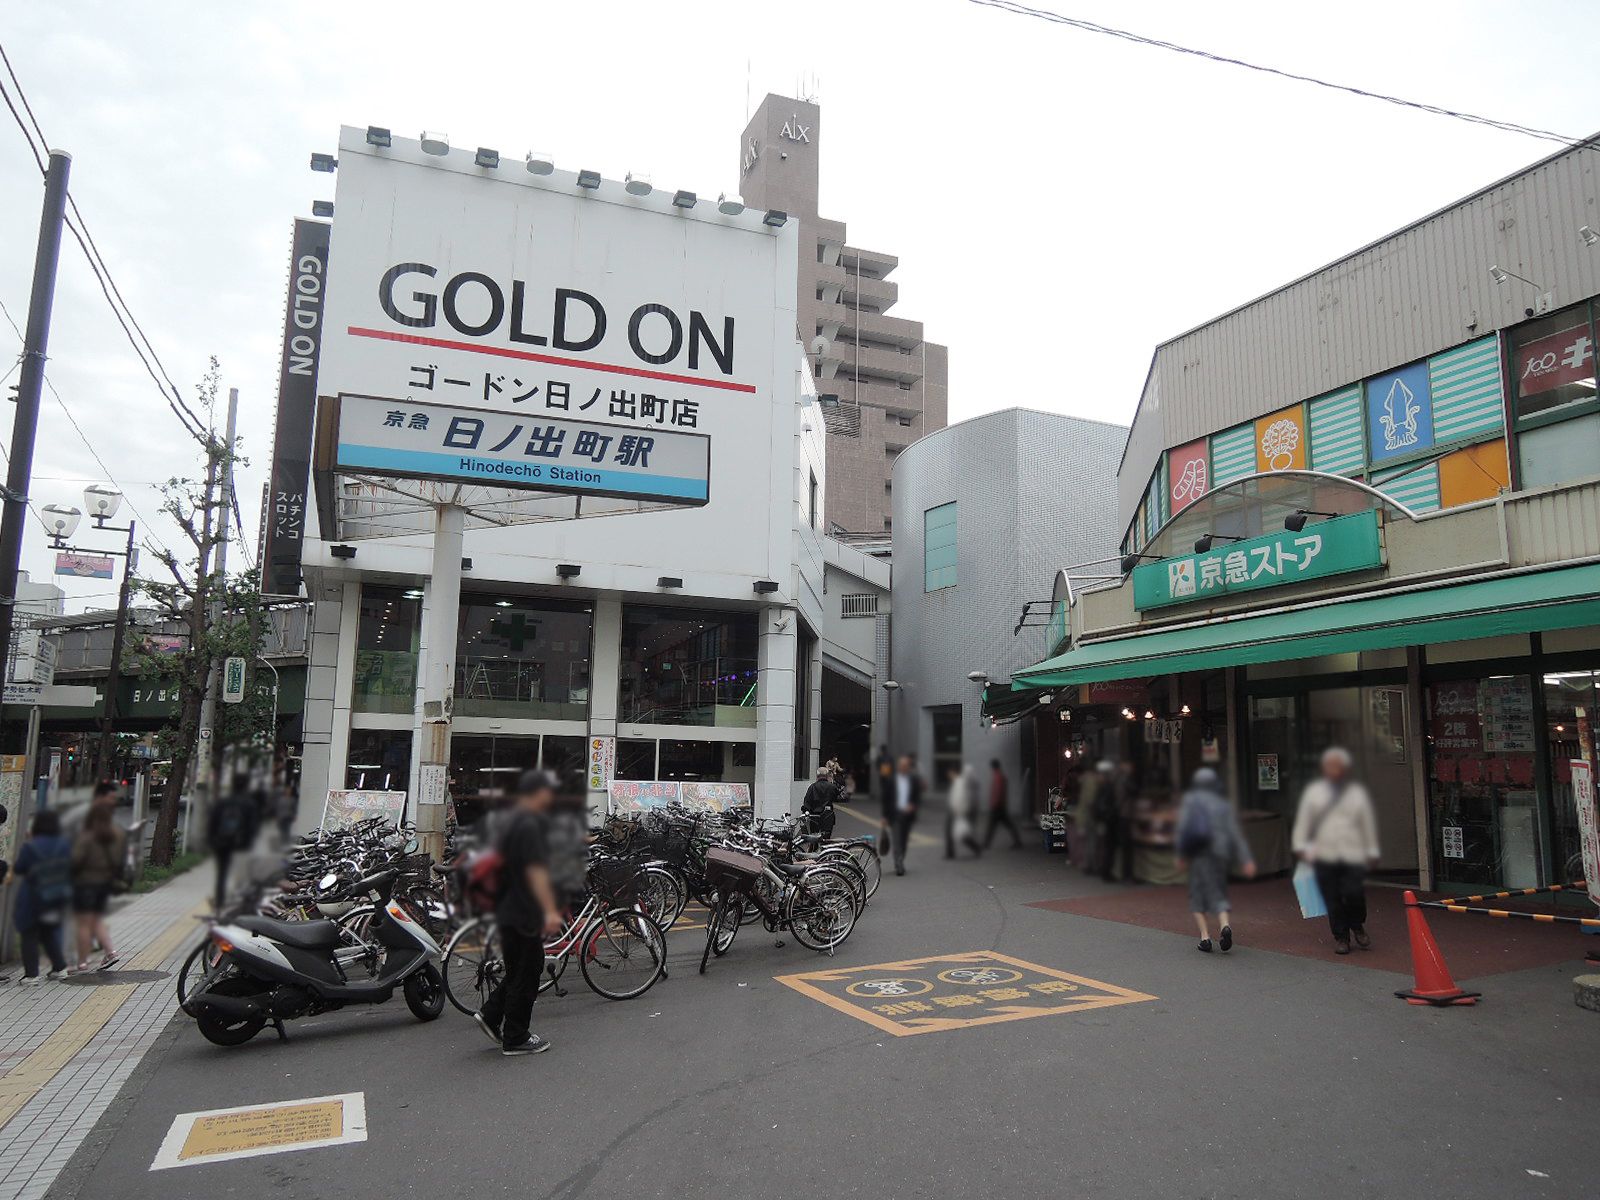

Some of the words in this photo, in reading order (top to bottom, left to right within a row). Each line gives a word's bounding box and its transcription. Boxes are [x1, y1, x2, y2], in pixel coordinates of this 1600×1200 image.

[294, 254, 322, 330] GOLD
[379, 262, 607, 351] GOLD
[627, 303, 735, 375] ON
[288, 335, 316, 376] ON
[408, 364, 700, 428] ゴードン日ノ出町店
[382, 410, 431, 431] 京急
[442, 416, 655, 467] 日ノ出町駅
[459, 458, 541, 478] Hinodechō
[550, 467, 602, 483] Station
[276, 491, 287, 537] スロット
[288, 493, 302, 539] パチンコ
[1199, 535, 1322, 589] 京急ストア
